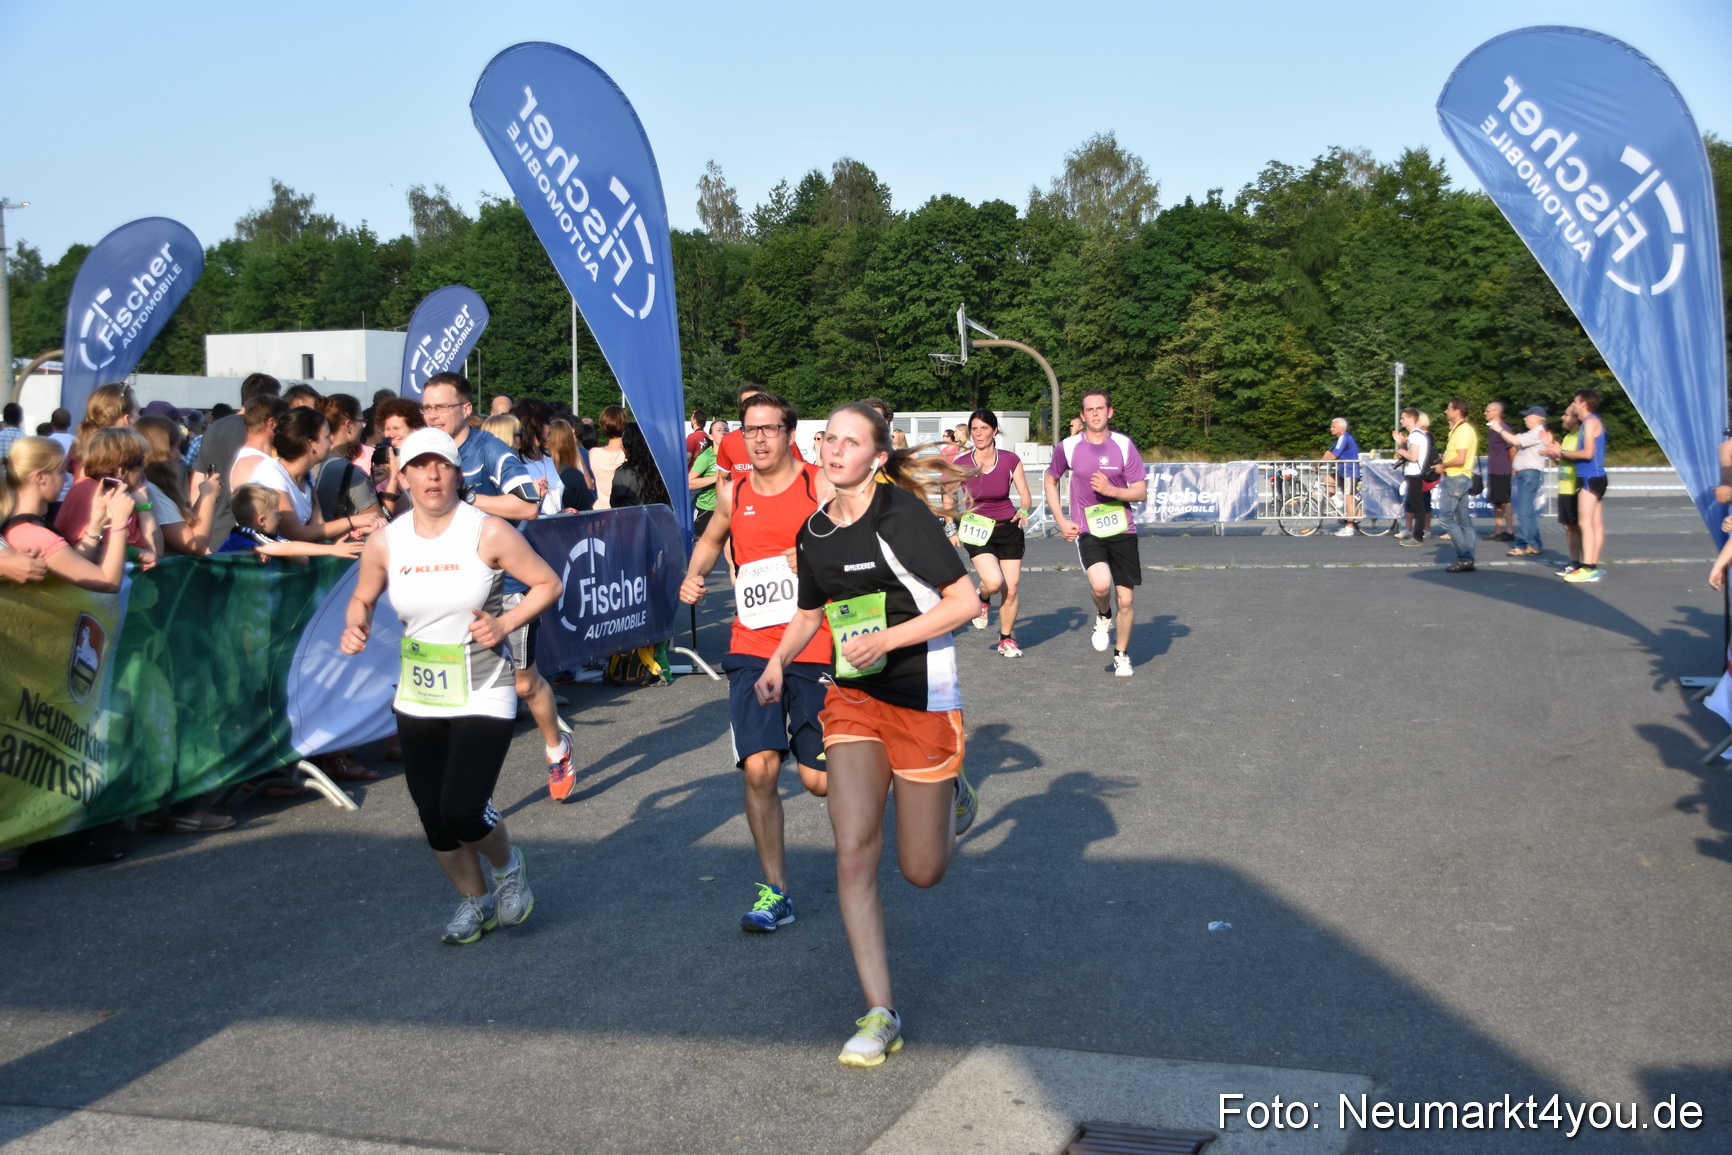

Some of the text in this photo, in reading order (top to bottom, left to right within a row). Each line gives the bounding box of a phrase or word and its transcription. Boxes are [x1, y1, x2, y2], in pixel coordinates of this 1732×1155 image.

[98, 242, 174, 352] Fischer
[122, 263, 183, 349] AUTOMOBILE
[422, 304, 470, 378] Fischer
[441, 318, 476, 373] UTOMOBILE
[734, 463, 754, 471] NEUM
[963, 523, 989, 540] 1110
[1096, 513, 1119, 529] 508
[415, 563, 464, 573] KLEBL
[743, 578, 795, 609] 8920
[583, 609, 647, 641] AUTOMOBILE
[413, 665, 448, 690] 591
[0, 733, 104, 806] ammsb
